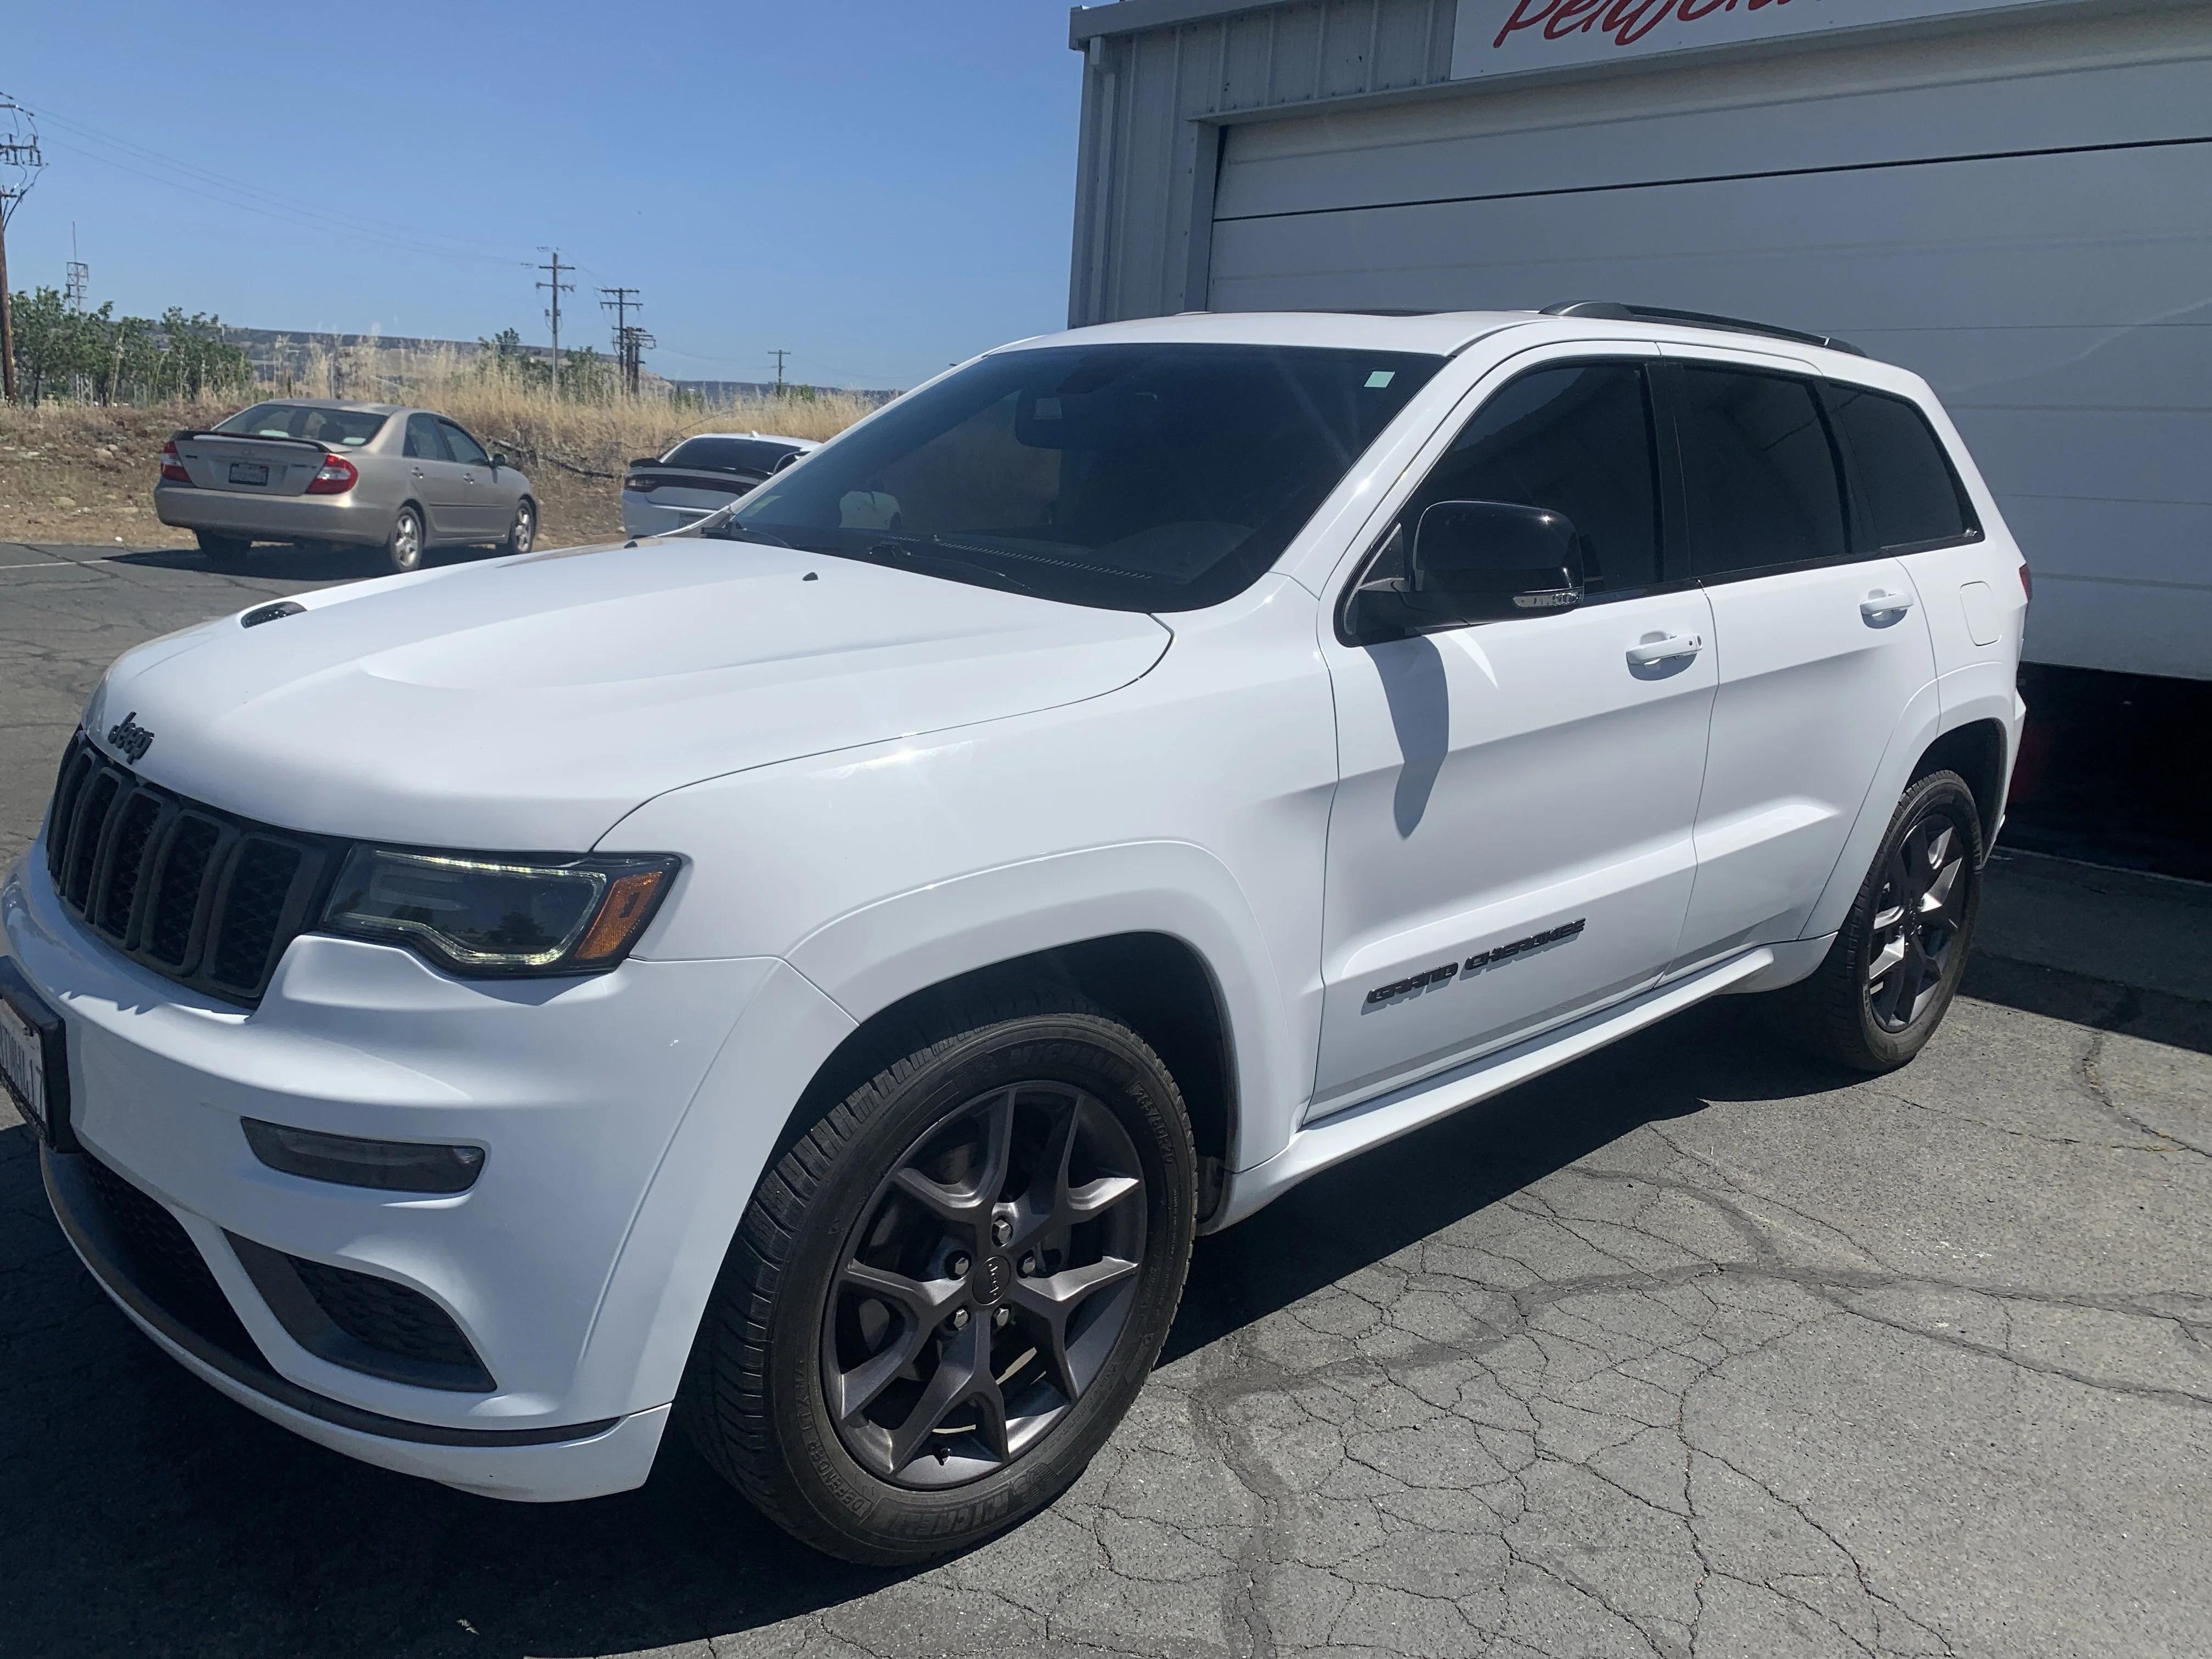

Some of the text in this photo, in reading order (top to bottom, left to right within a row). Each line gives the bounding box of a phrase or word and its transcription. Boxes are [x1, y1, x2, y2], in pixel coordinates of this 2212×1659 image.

[108, 711, 154, 765] Jeep
[1367, 917, 1586, 1004] GRAND CHEROKEE
